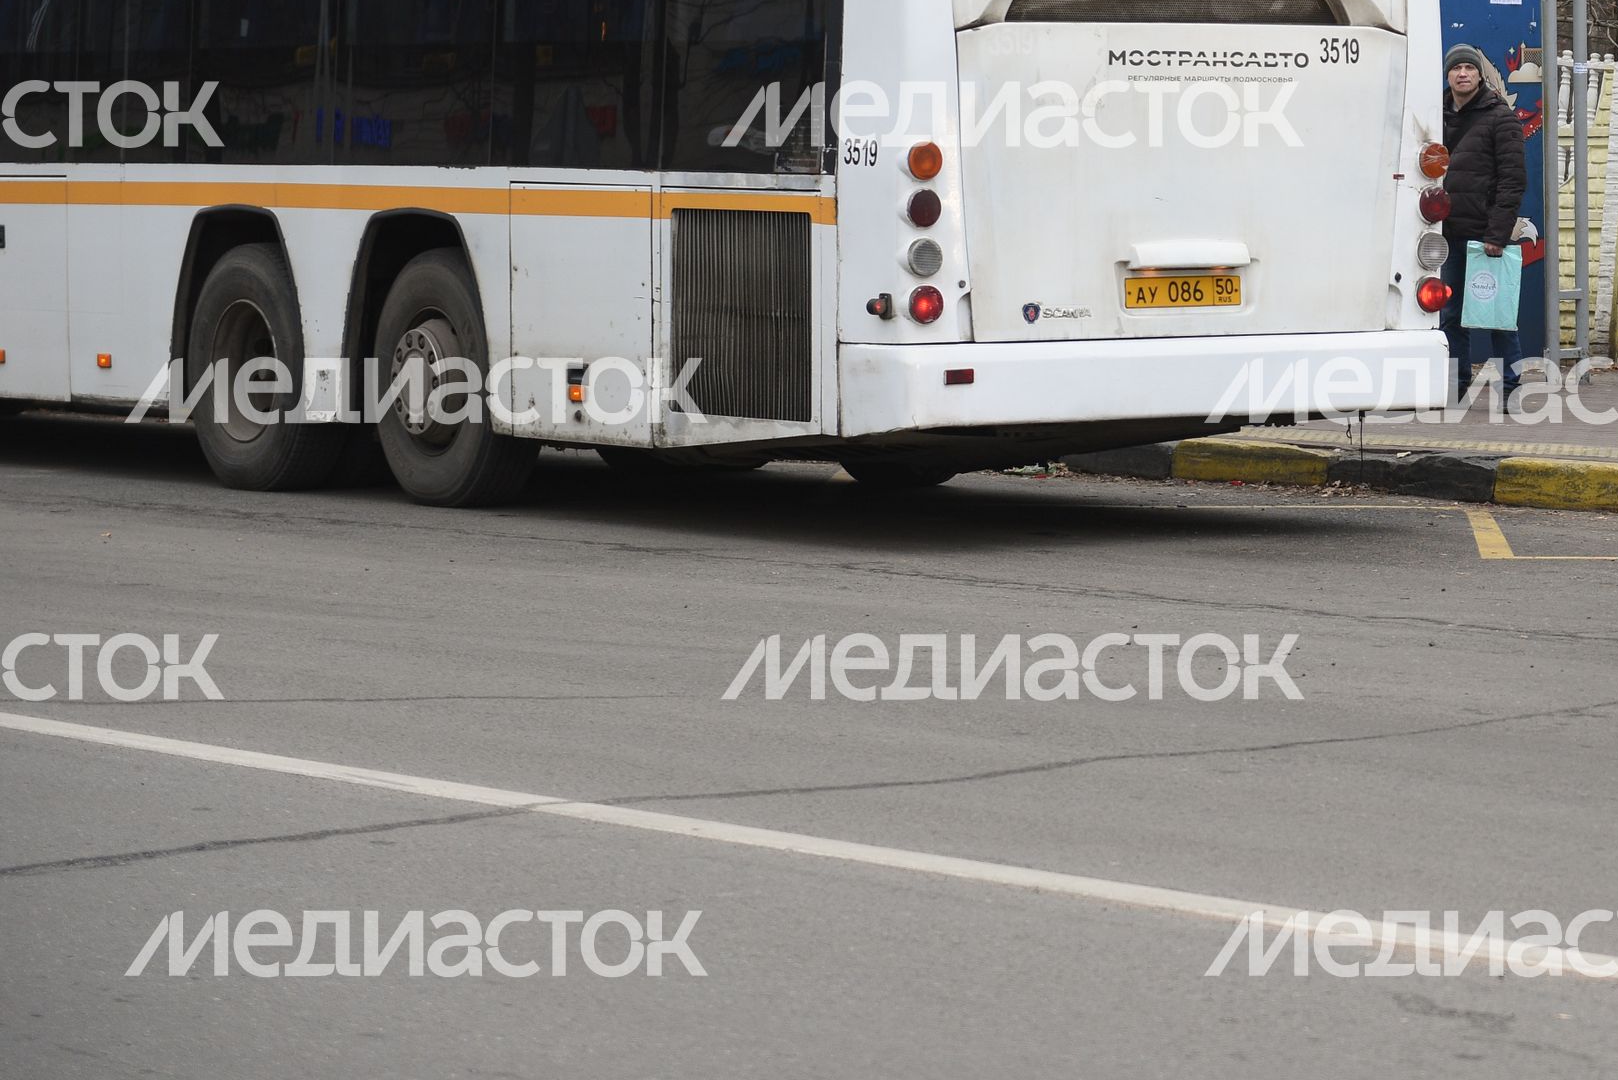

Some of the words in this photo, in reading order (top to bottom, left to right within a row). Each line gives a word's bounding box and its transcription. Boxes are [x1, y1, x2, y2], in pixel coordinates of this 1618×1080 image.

[1109, 49, 1309, 69] МОСТРАНСАВТО
[1320, 38, 1360, 64] 3519
[1127, 75, 1182, 83] РЕГУЛЯРНЫЕ
[844, 137, 877, 167] 3519
[1168, 280, 1204, 303] 086
[1215, 278, 1233, 295] 50
